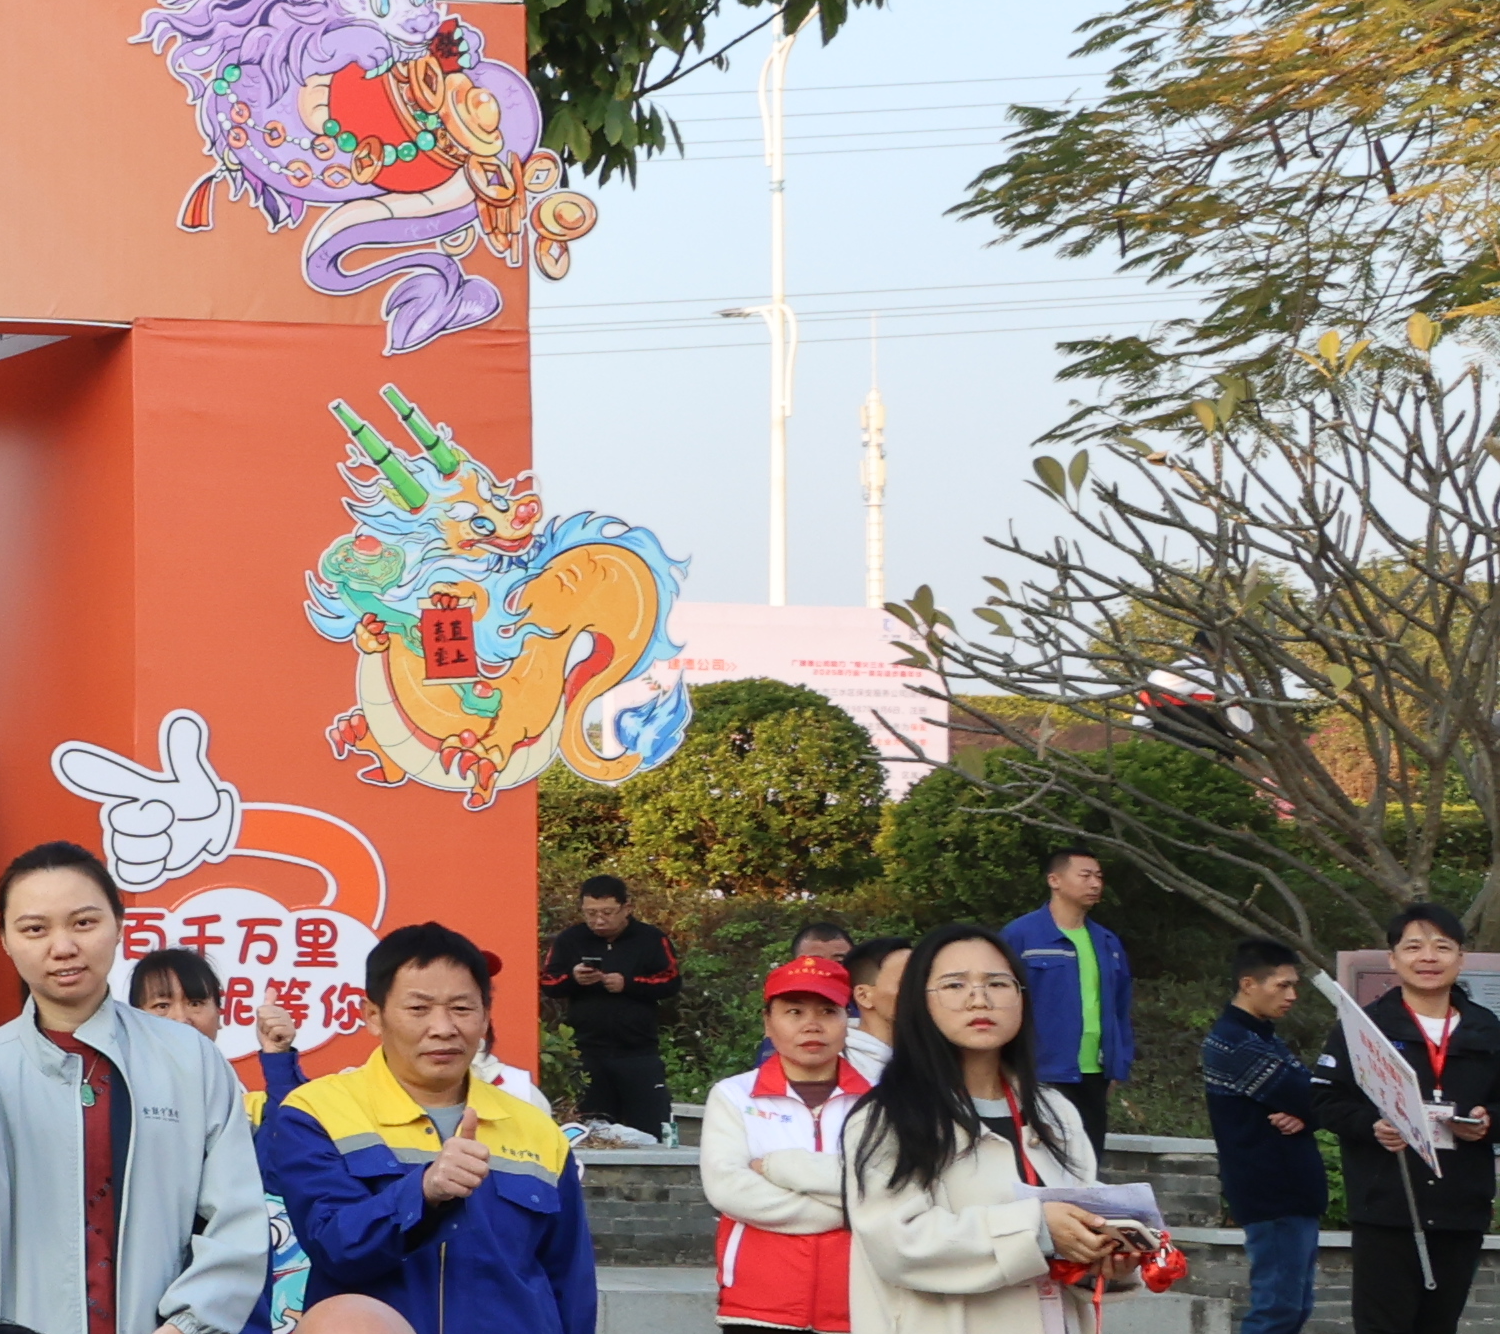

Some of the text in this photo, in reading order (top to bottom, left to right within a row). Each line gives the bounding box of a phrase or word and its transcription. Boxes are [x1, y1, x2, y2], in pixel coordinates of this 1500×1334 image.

[123, 911, 338, 969] 百千万里
[220, 978, 367, 1031] 坭等你
